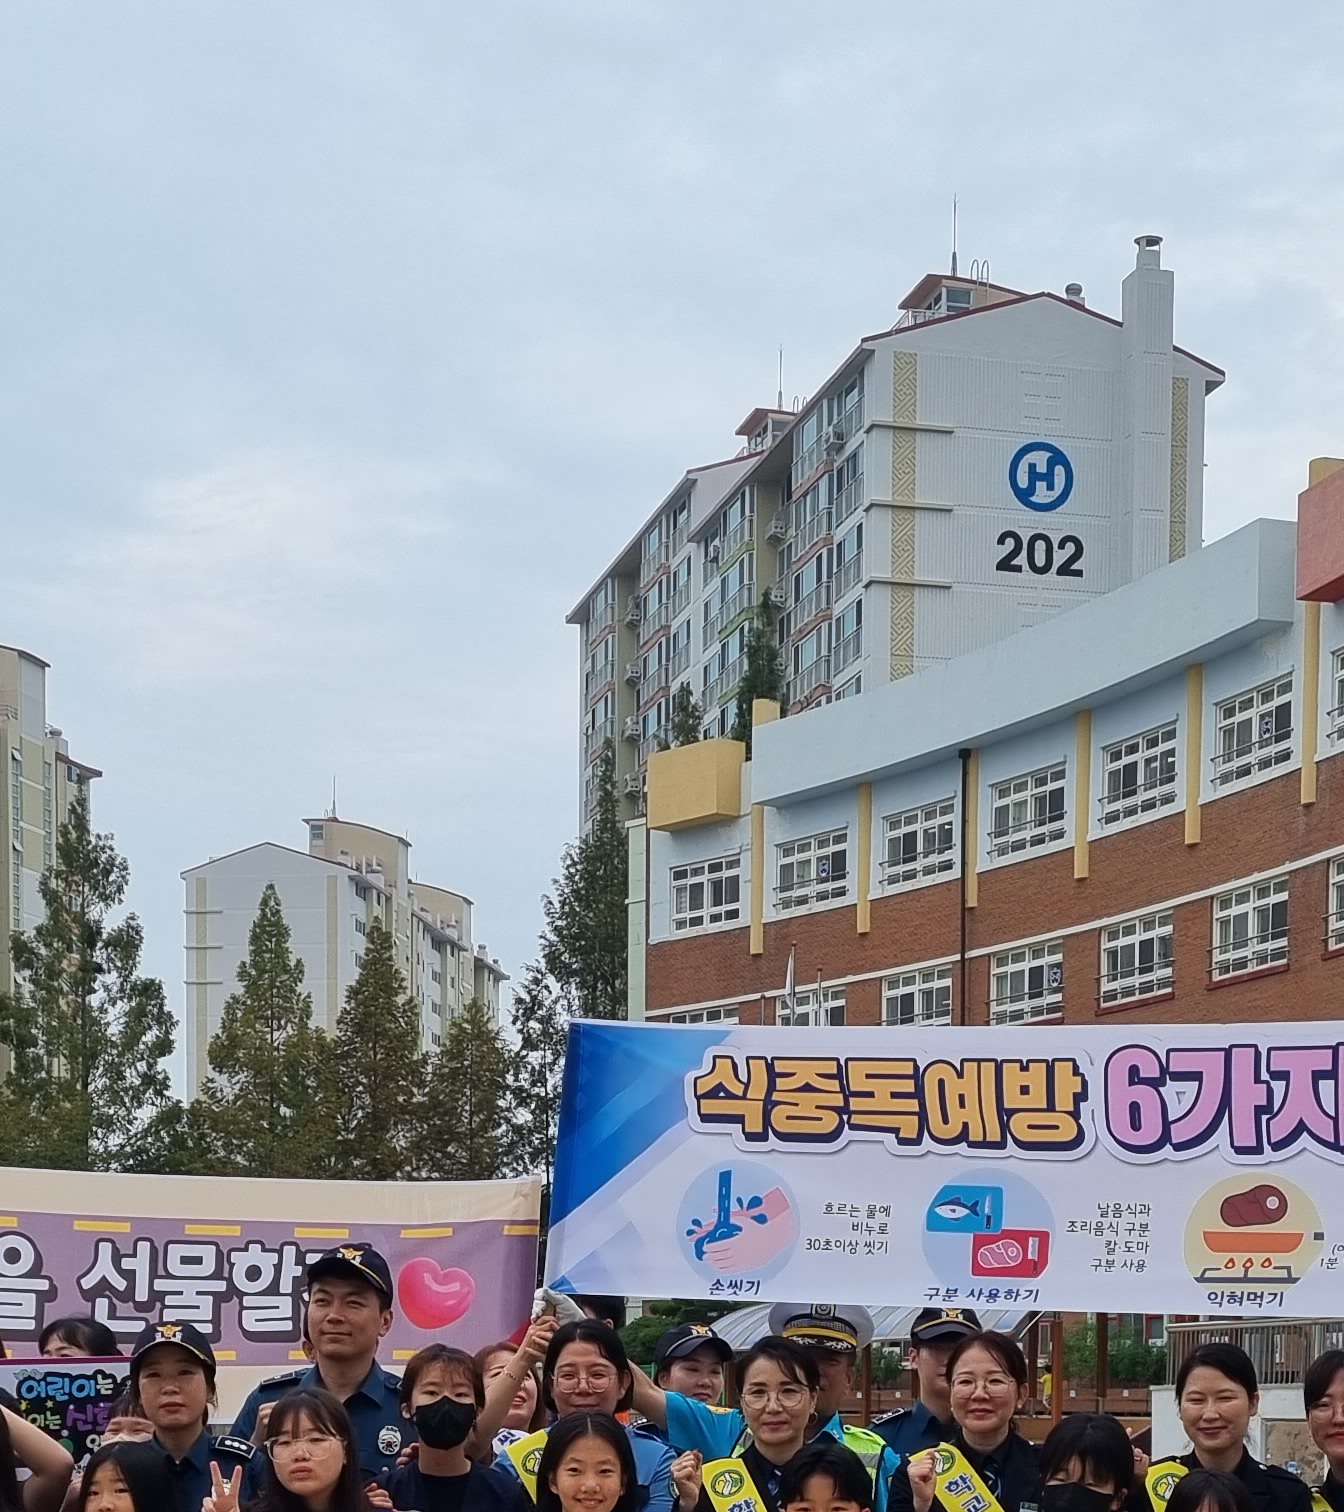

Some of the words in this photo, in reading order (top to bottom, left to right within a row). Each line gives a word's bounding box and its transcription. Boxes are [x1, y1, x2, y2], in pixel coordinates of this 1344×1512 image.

[995, 530, 1084, 578] 202
[693, 1055, 1088, 1150] 식중독예방
[822, 1202, 861, 1218] 흐르는
[865, 1204, 892, 1218] 물에
[1097, 1202, 1152, 1218] 날음식과
[851, 1221, 890, 1236] 비누로
[1066, 1220, 1120, 1237] 조리음식
[1123, 1222, 1151, 1238] 구분
[805, 1238, 859, 1254] 30초이상
[863, 1240, 889, 1255] 씻기
[1090, 1258, 1116, 1273] 구분
[1120, 1258, 1147, 1273] 사용
[1320, 1257, 1338, 1270] 1분
[76, 1239, 312, 1344] 선물할
[708, 1278, 761, 1296] 손씻기
[923, 1288, 959, 1303] 구분
[965, 1287, 1040, 1304] 사용하기
[1207, 1290, 1284, 1308] 익혀먹기
[20, 1373, 114, 1401] 어린이는
